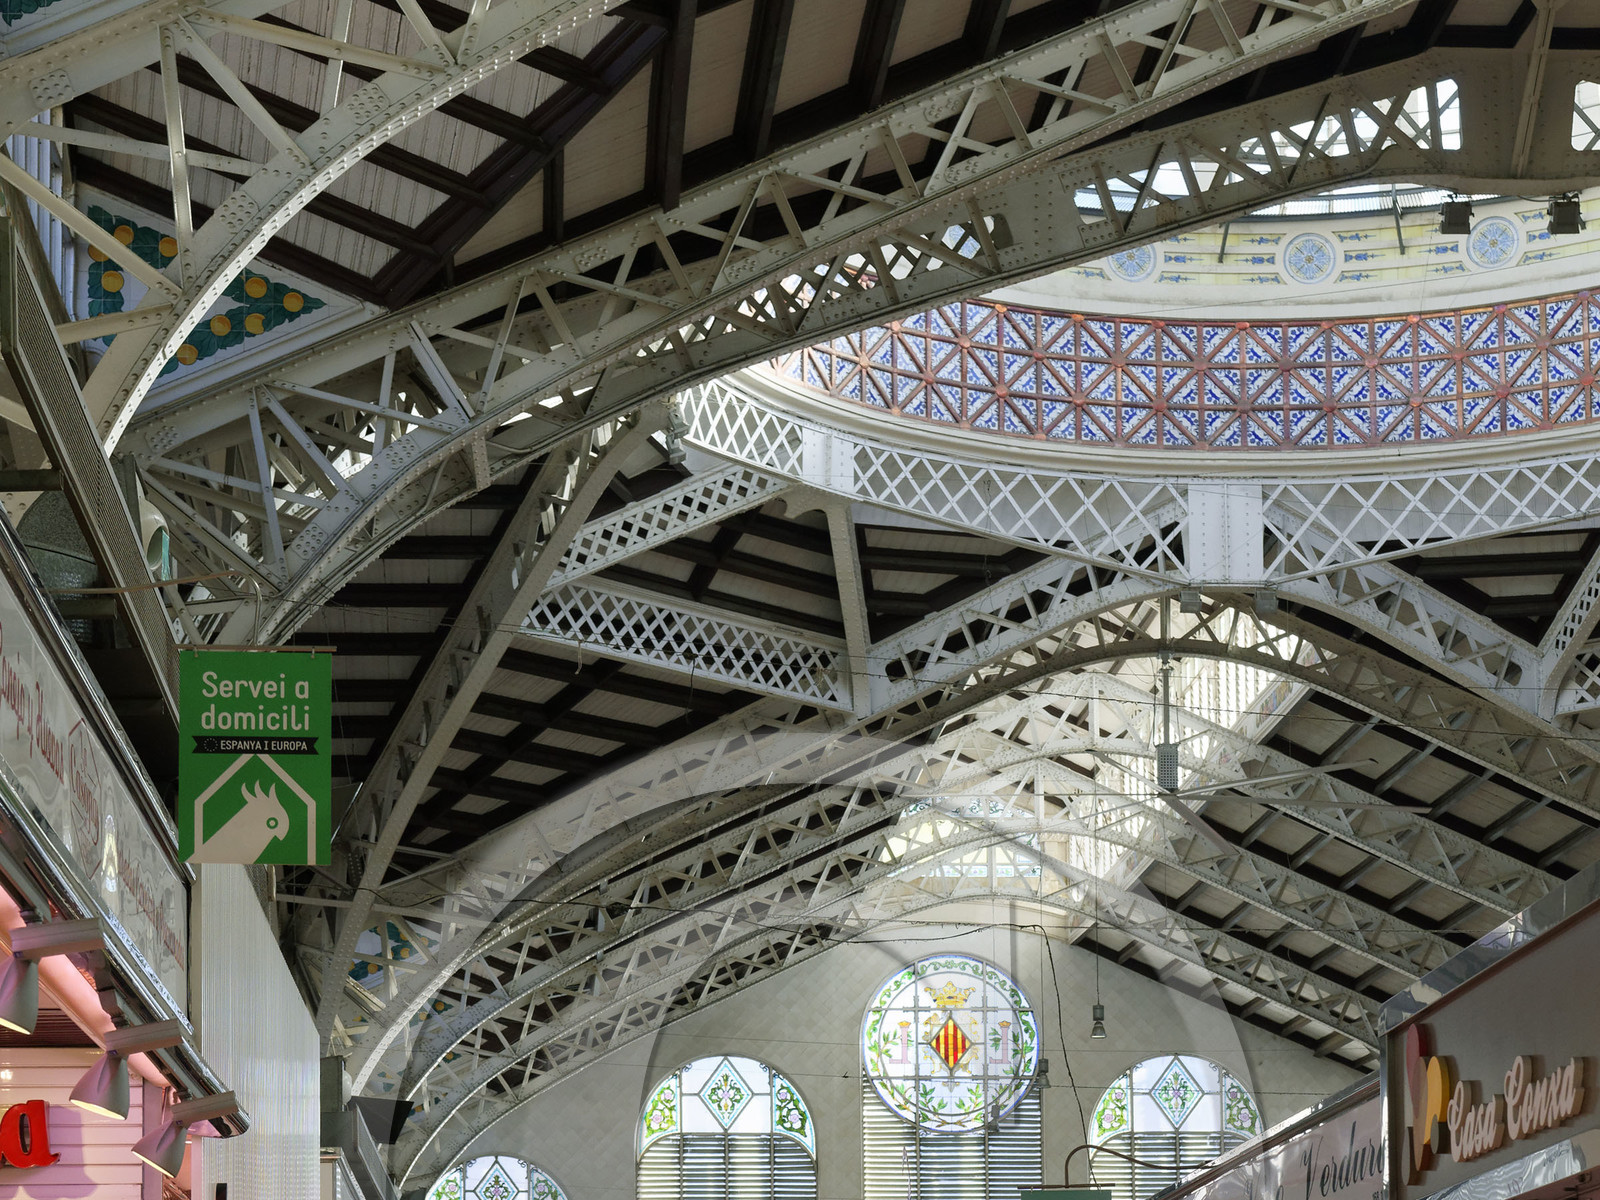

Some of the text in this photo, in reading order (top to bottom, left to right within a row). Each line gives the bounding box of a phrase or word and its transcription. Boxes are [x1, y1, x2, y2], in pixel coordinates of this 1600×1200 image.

[202, 671, 310, 699] Servei a
[201, 703, 310, 731] domicili
[220, 740, 308, 751] ESPANYA I EUROPA
[1447, 1055, 1582, 1162] Casa Conxa
